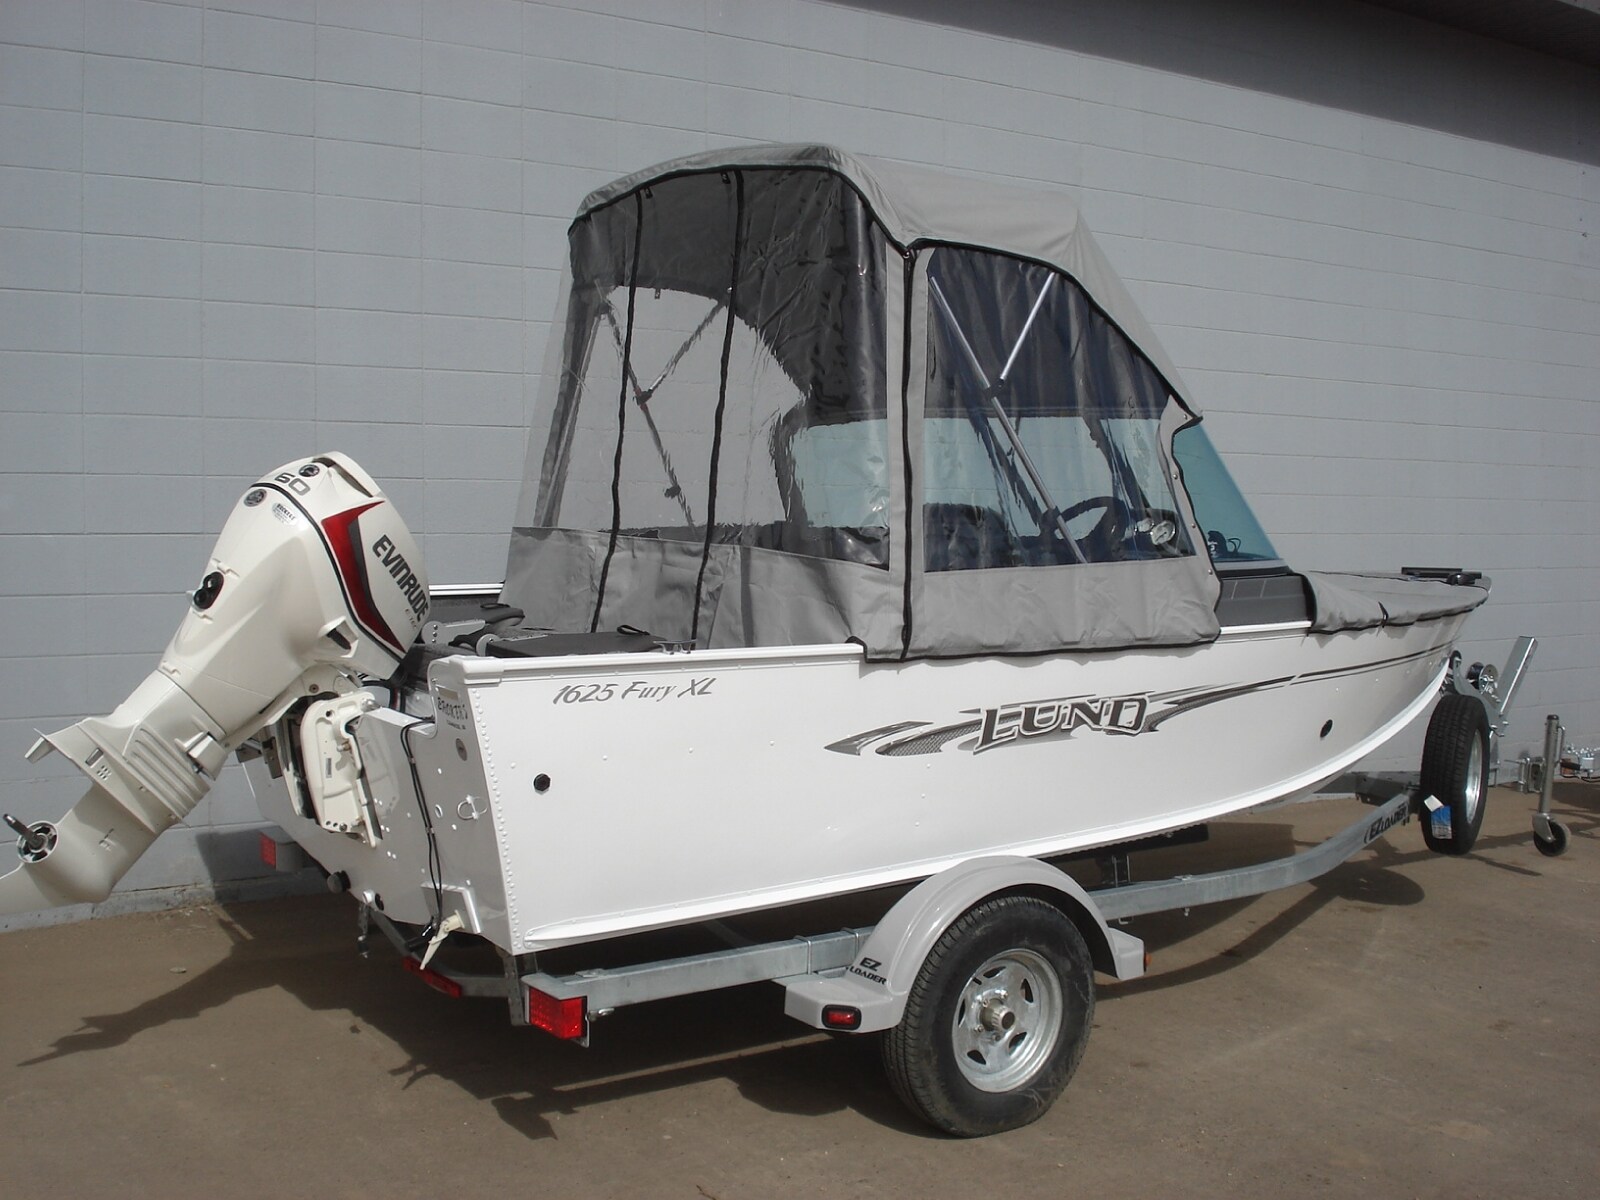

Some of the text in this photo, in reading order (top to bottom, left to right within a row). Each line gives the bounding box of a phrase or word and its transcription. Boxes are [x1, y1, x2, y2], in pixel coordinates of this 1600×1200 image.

[274, 472, 311, 496] 60
[372, 534, 429, 622] EVINRUDE
[553, 677, 717, 705] 1625 Fury XL
[973, 694, 1150, 755] LUND
[849, 965, 888, 985] LOADER
[860, 957, 882, 972] EZ
